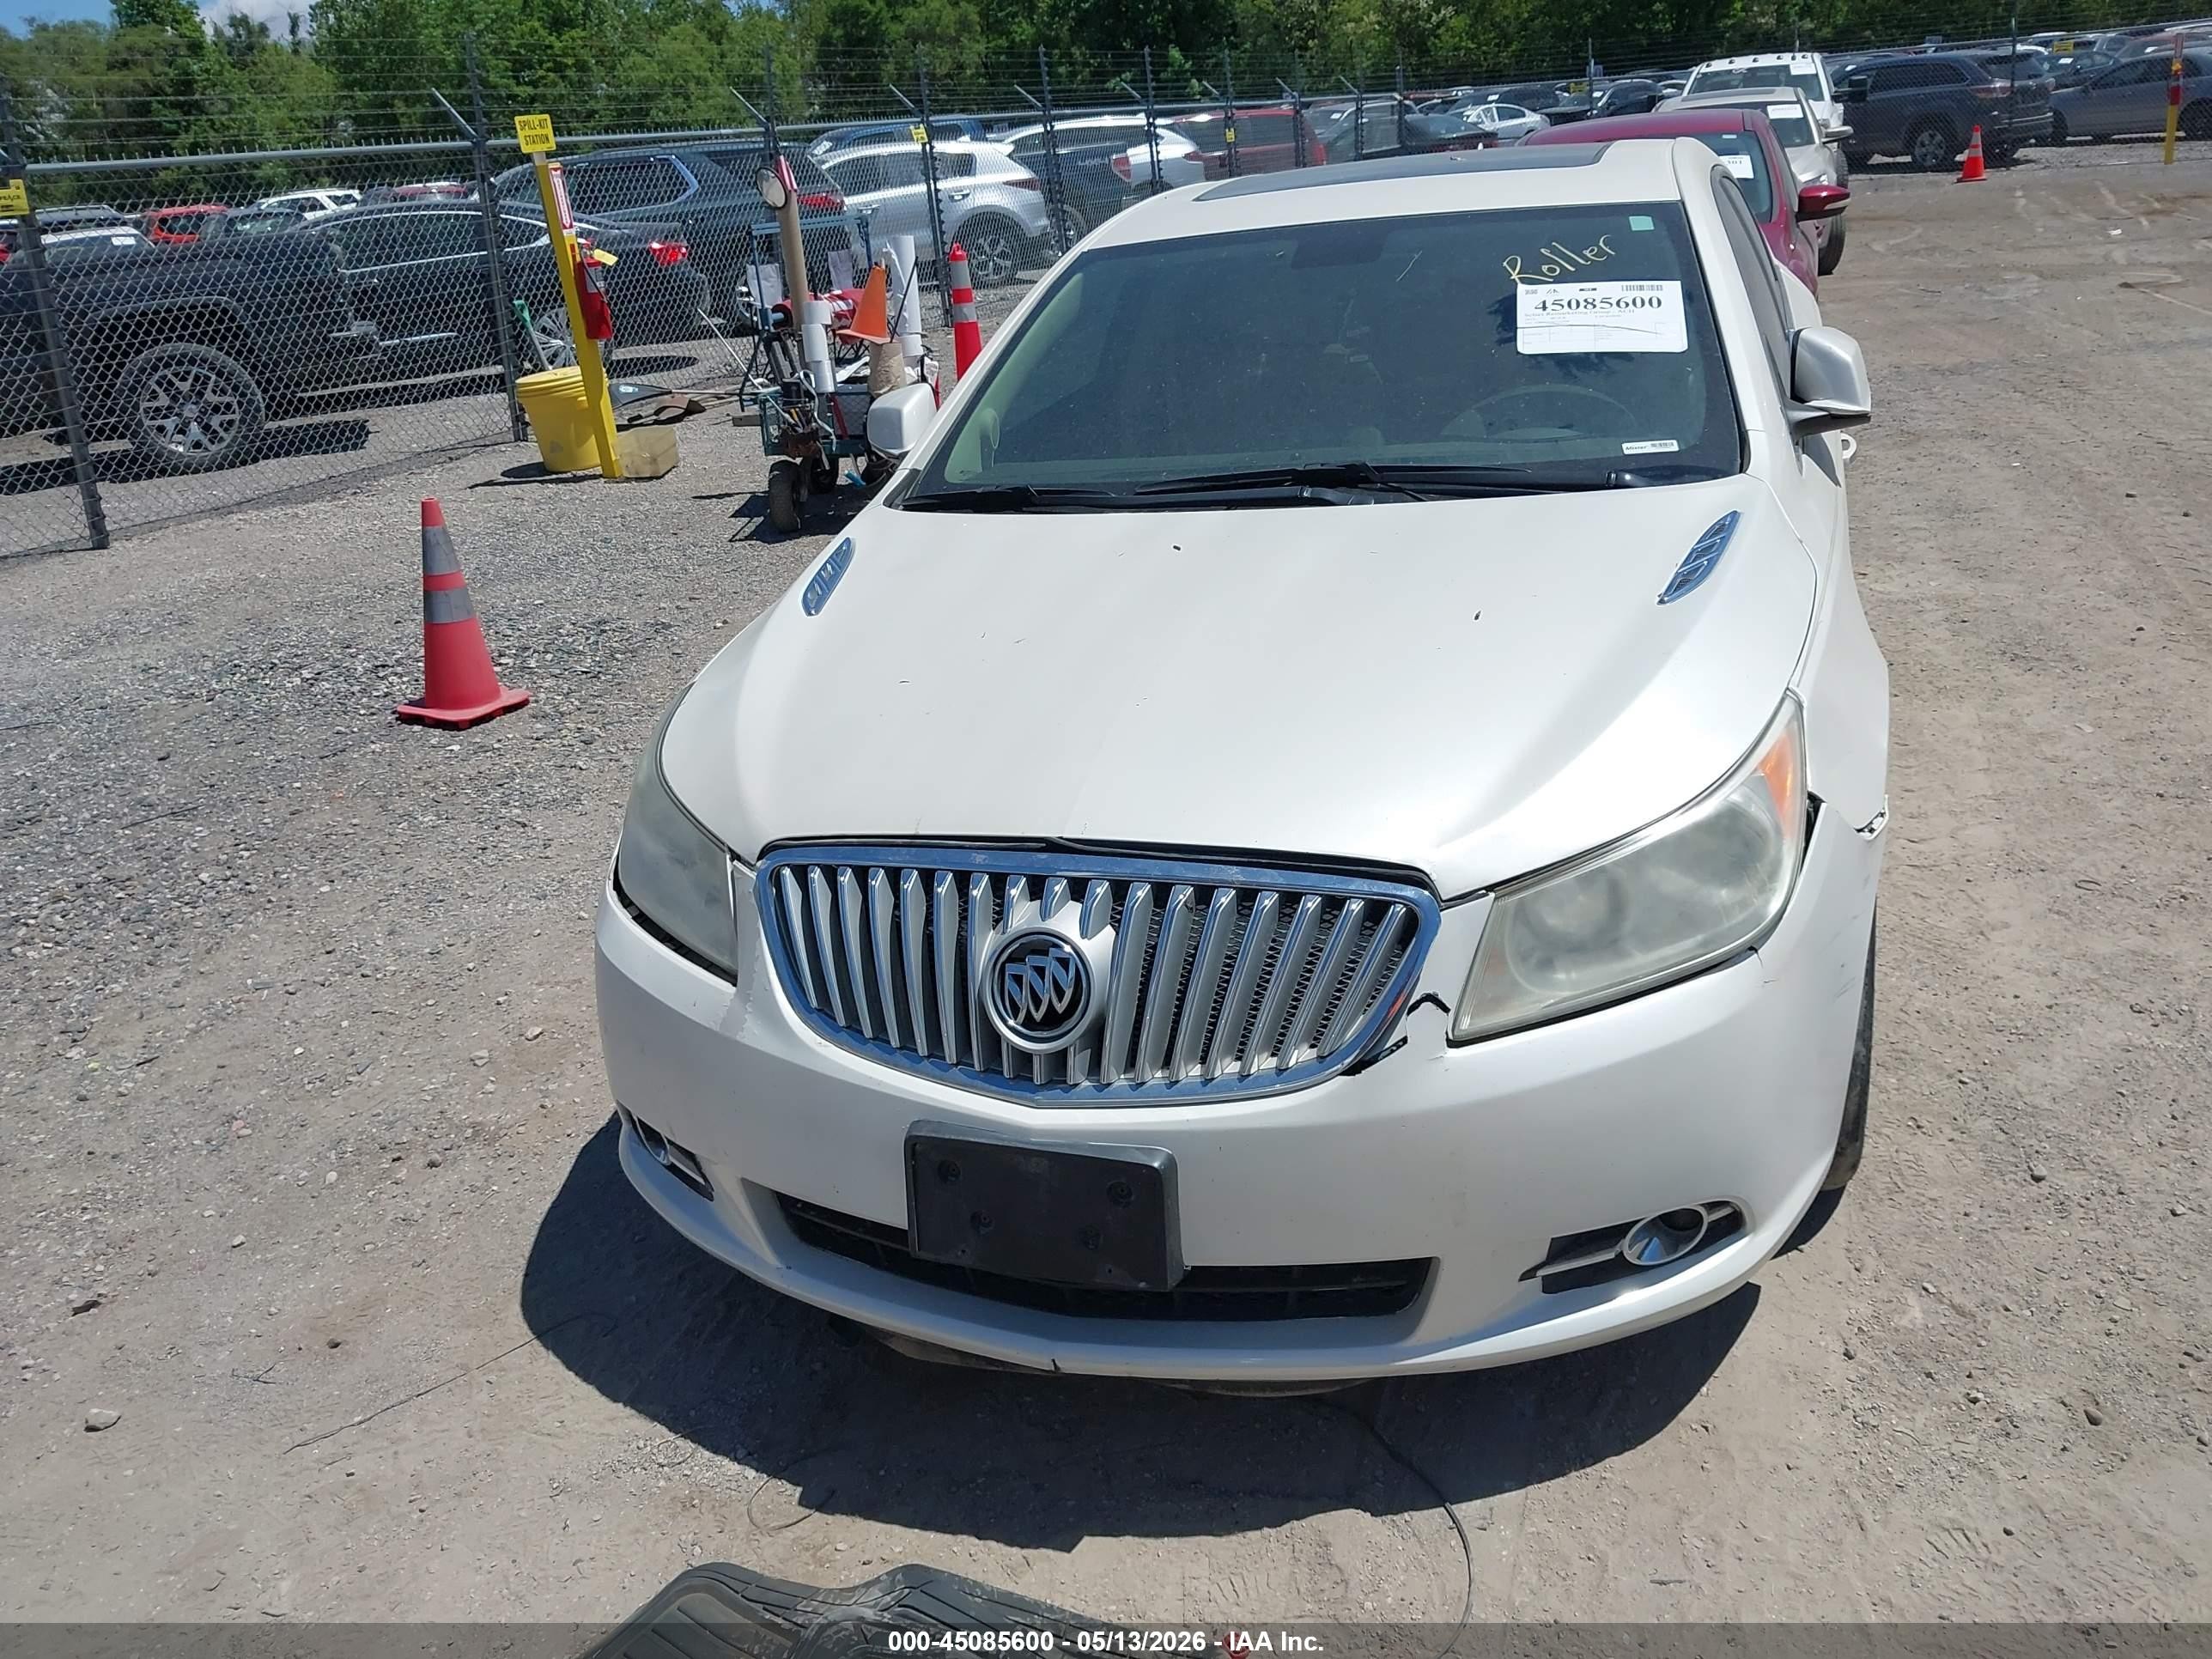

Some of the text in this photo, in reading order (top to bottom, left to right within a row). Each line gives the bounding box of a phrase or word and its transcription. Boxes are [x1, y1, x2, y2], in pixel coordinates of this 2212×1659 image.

[518, 118, 549, 131] SPILL-KIT
[524, 133, 550, 146] STATION
[1503, 234, 1616, 285] Roller
[1534, 295, 1662, 312] 45085600
